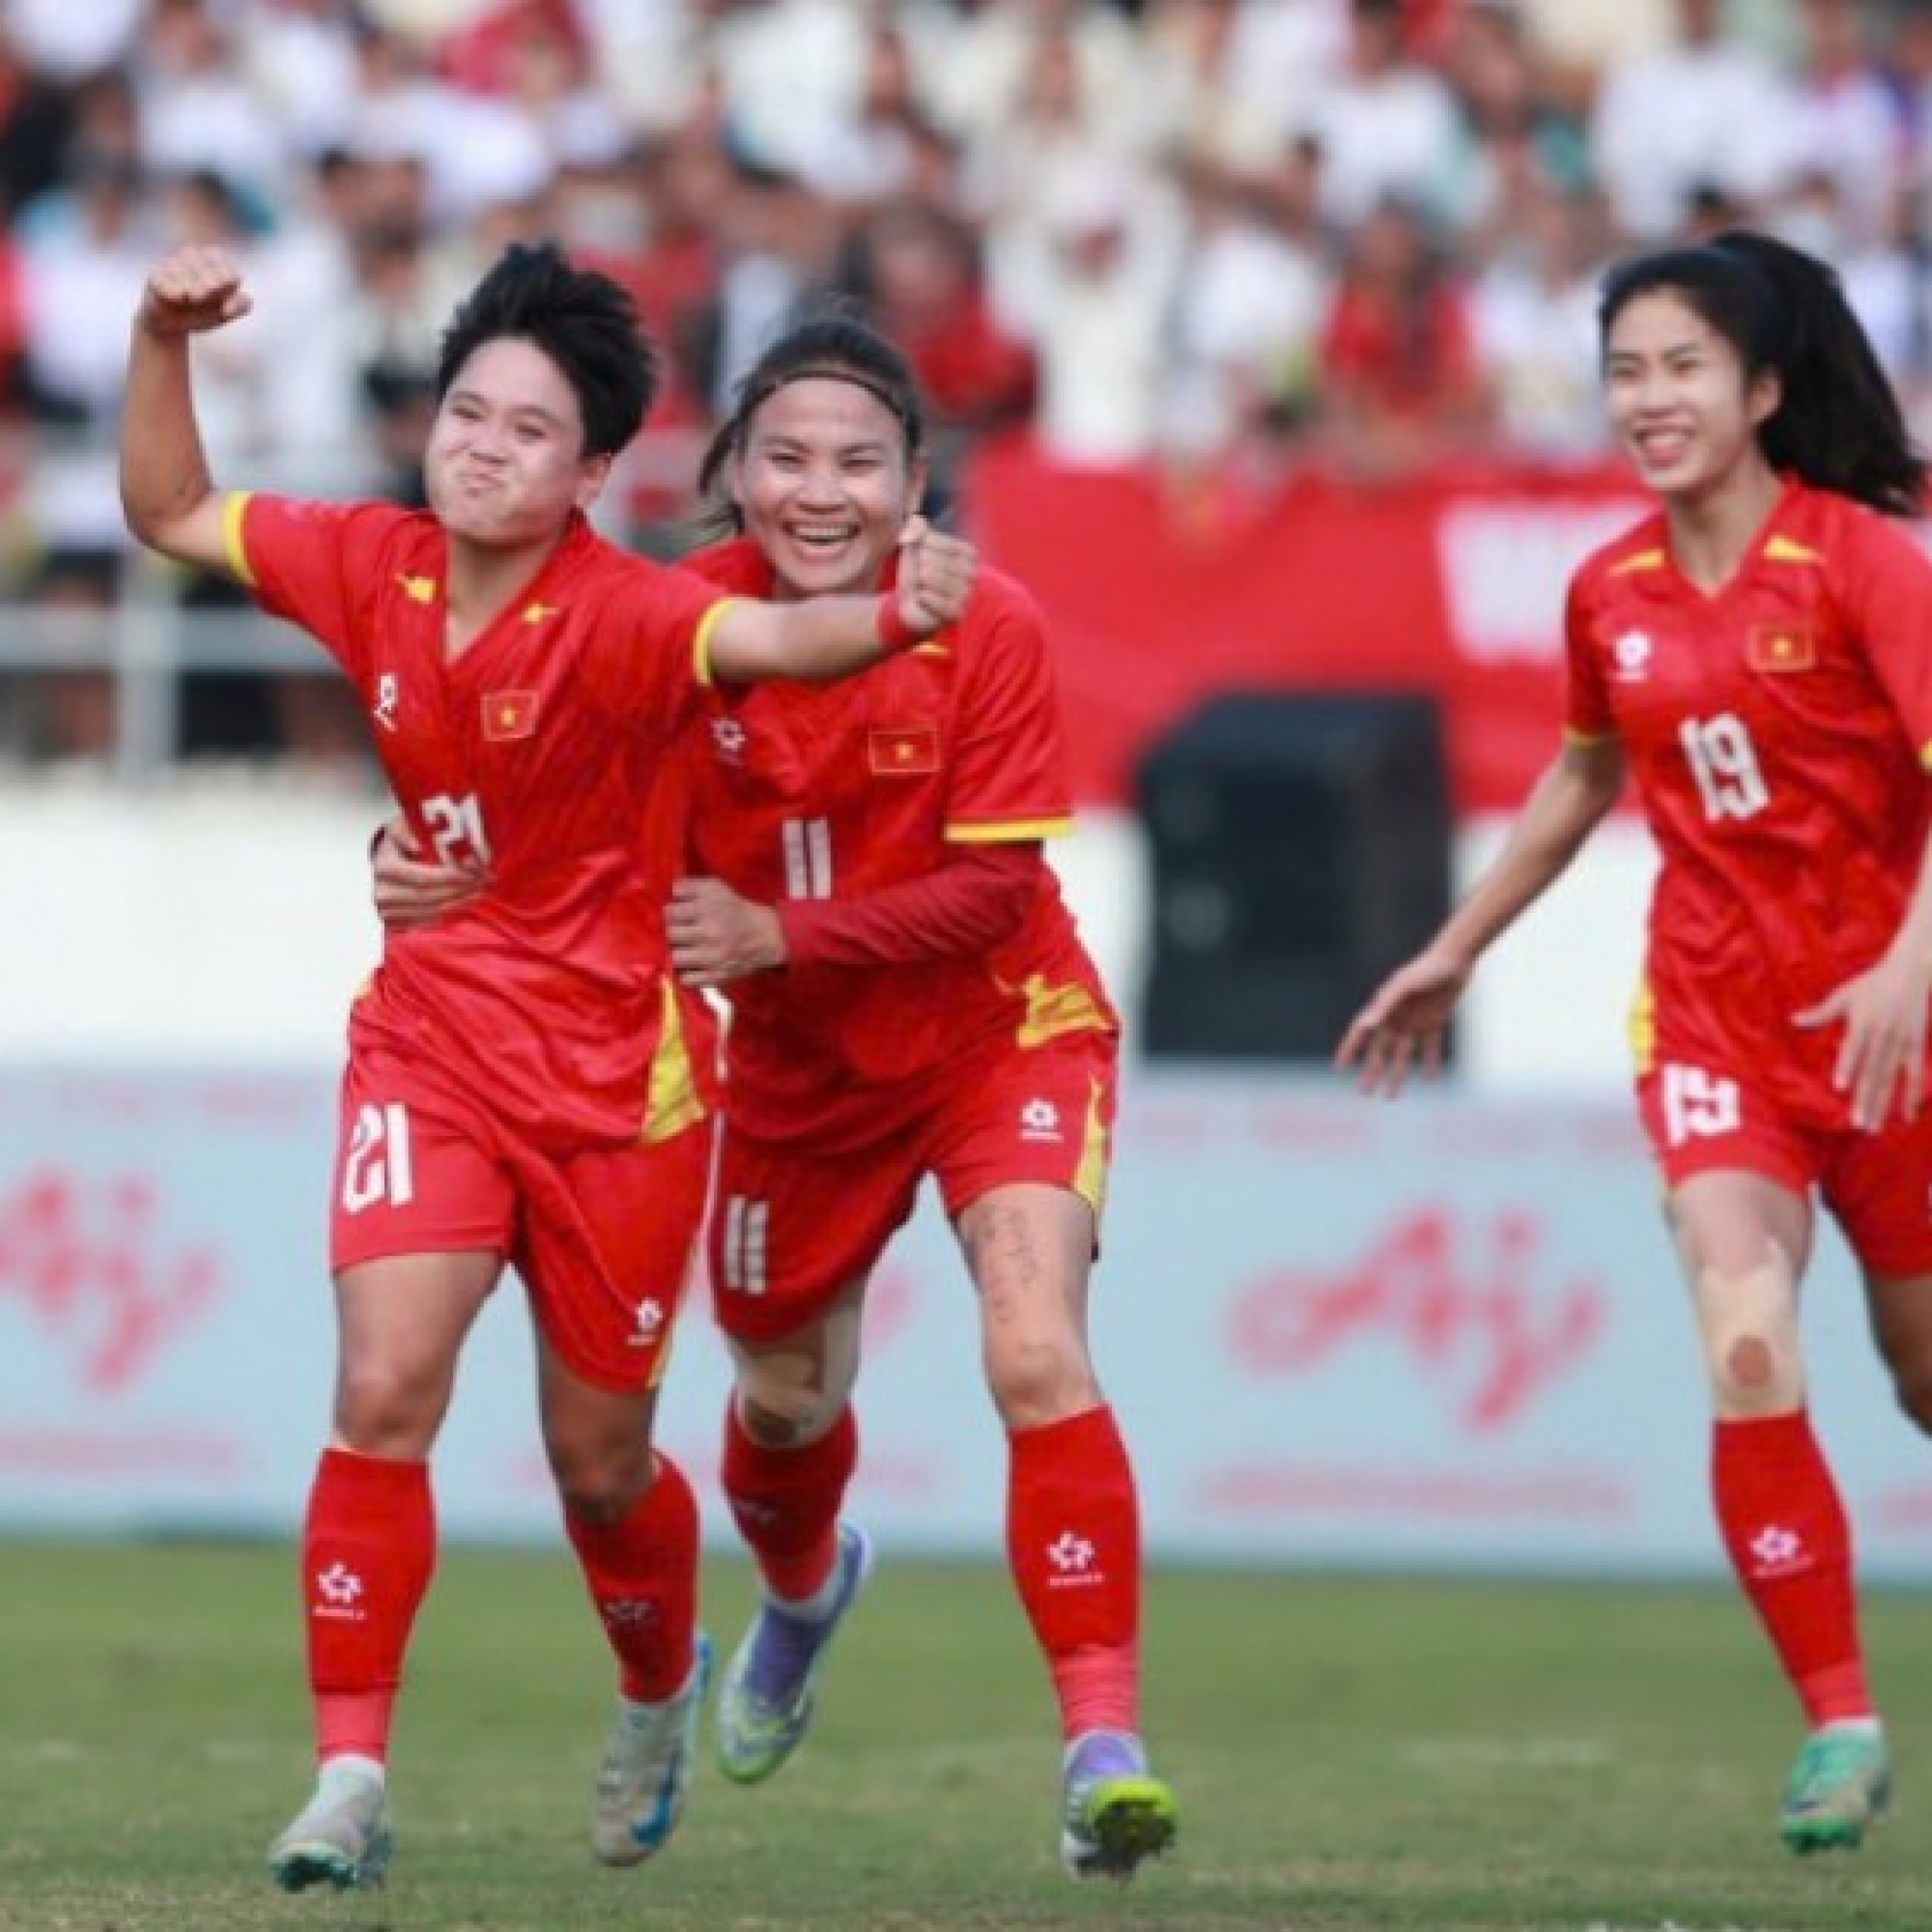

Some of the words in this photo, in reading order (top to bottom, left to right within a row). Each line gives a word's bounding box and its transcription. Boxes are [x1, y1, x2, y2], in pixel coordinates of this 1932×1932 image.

[1678, 713, 1769, 822] 19
[421, 792, 491, 867] 21
[781, 818, 832, 900] 11
[341, 1102, 413, 1213] 21
[724, 1196, 768, 1293] 11
